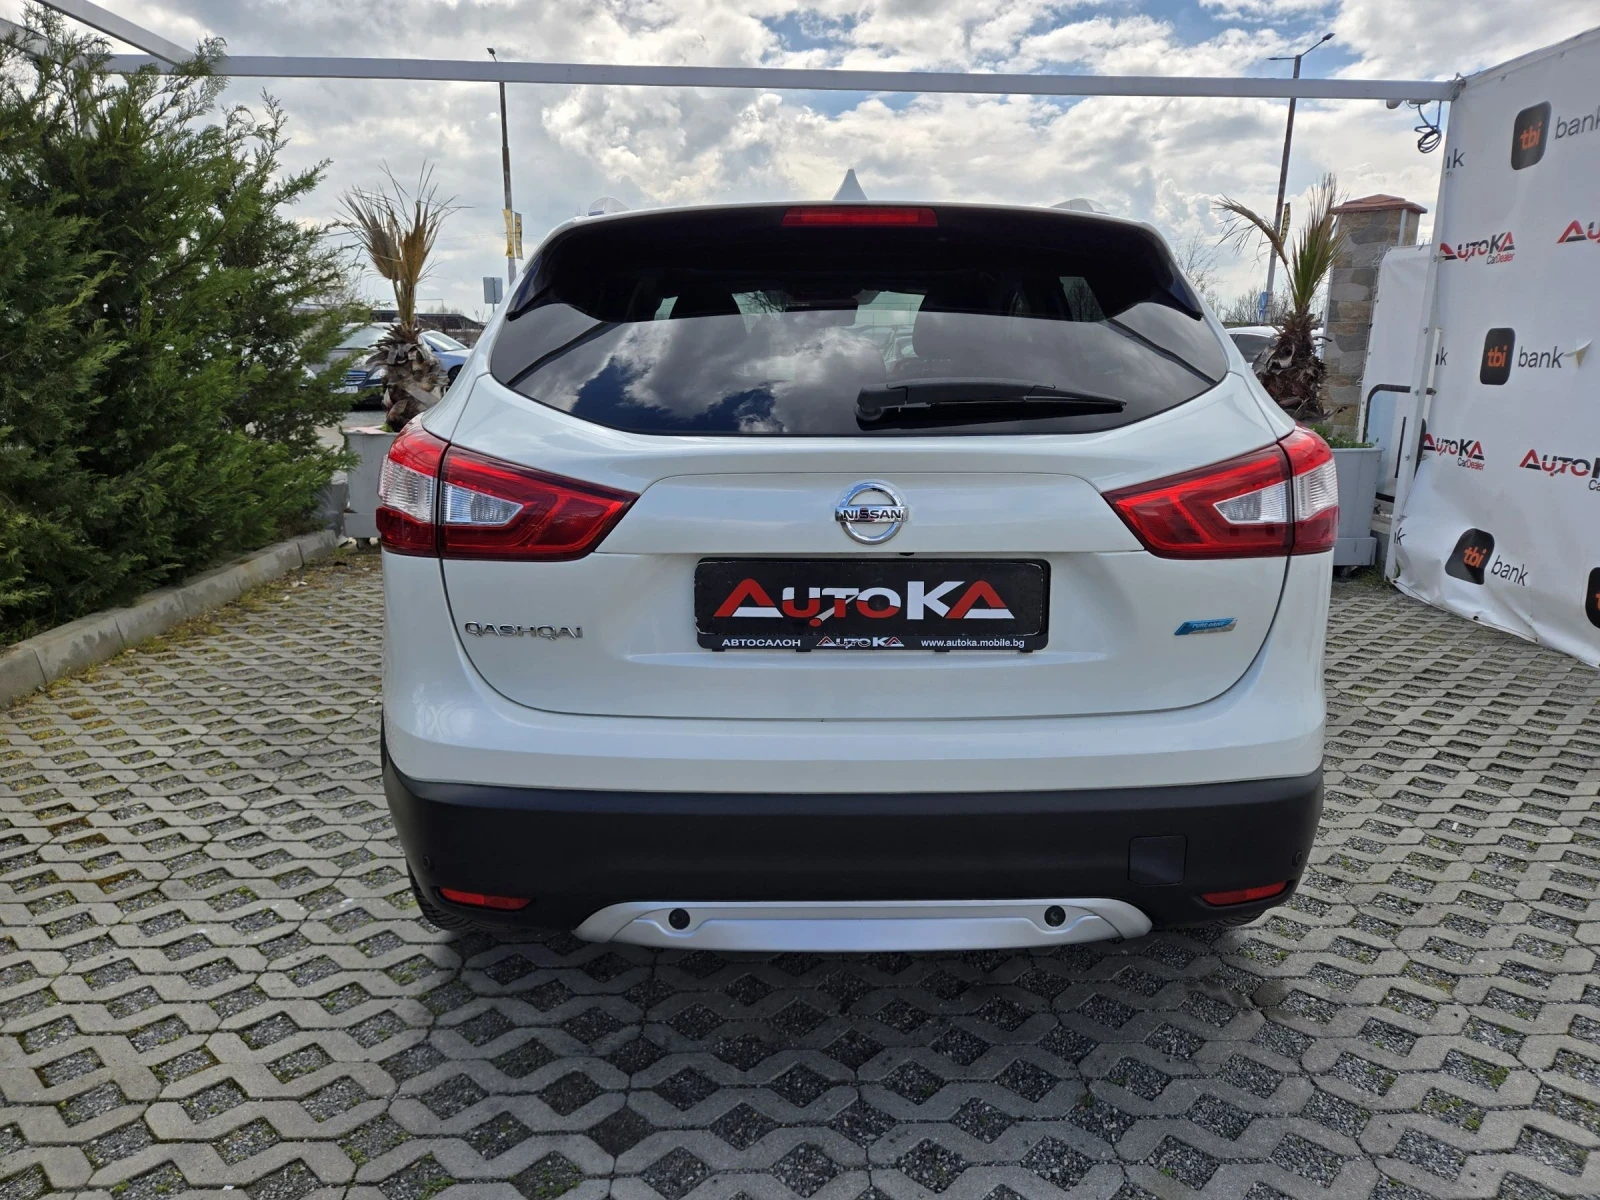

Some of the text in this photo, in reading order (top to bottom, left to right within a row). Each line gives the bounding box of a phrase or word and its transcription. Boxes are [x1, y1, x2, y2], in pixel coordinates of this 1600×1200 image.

[1520, 121, 1543, 150] tbi
[1487, 344, 1564, 368] tbi bank
[843, 509, 902, 520] NISSAN
[1463, 546, 1528, 587] tbi bank
[464, 620, 584, 641] QASHQAI
[721, 638, 801, 648] АВТОСАЛОН
[920, 637, 1025, 649] www.autoka.mobile.bg
